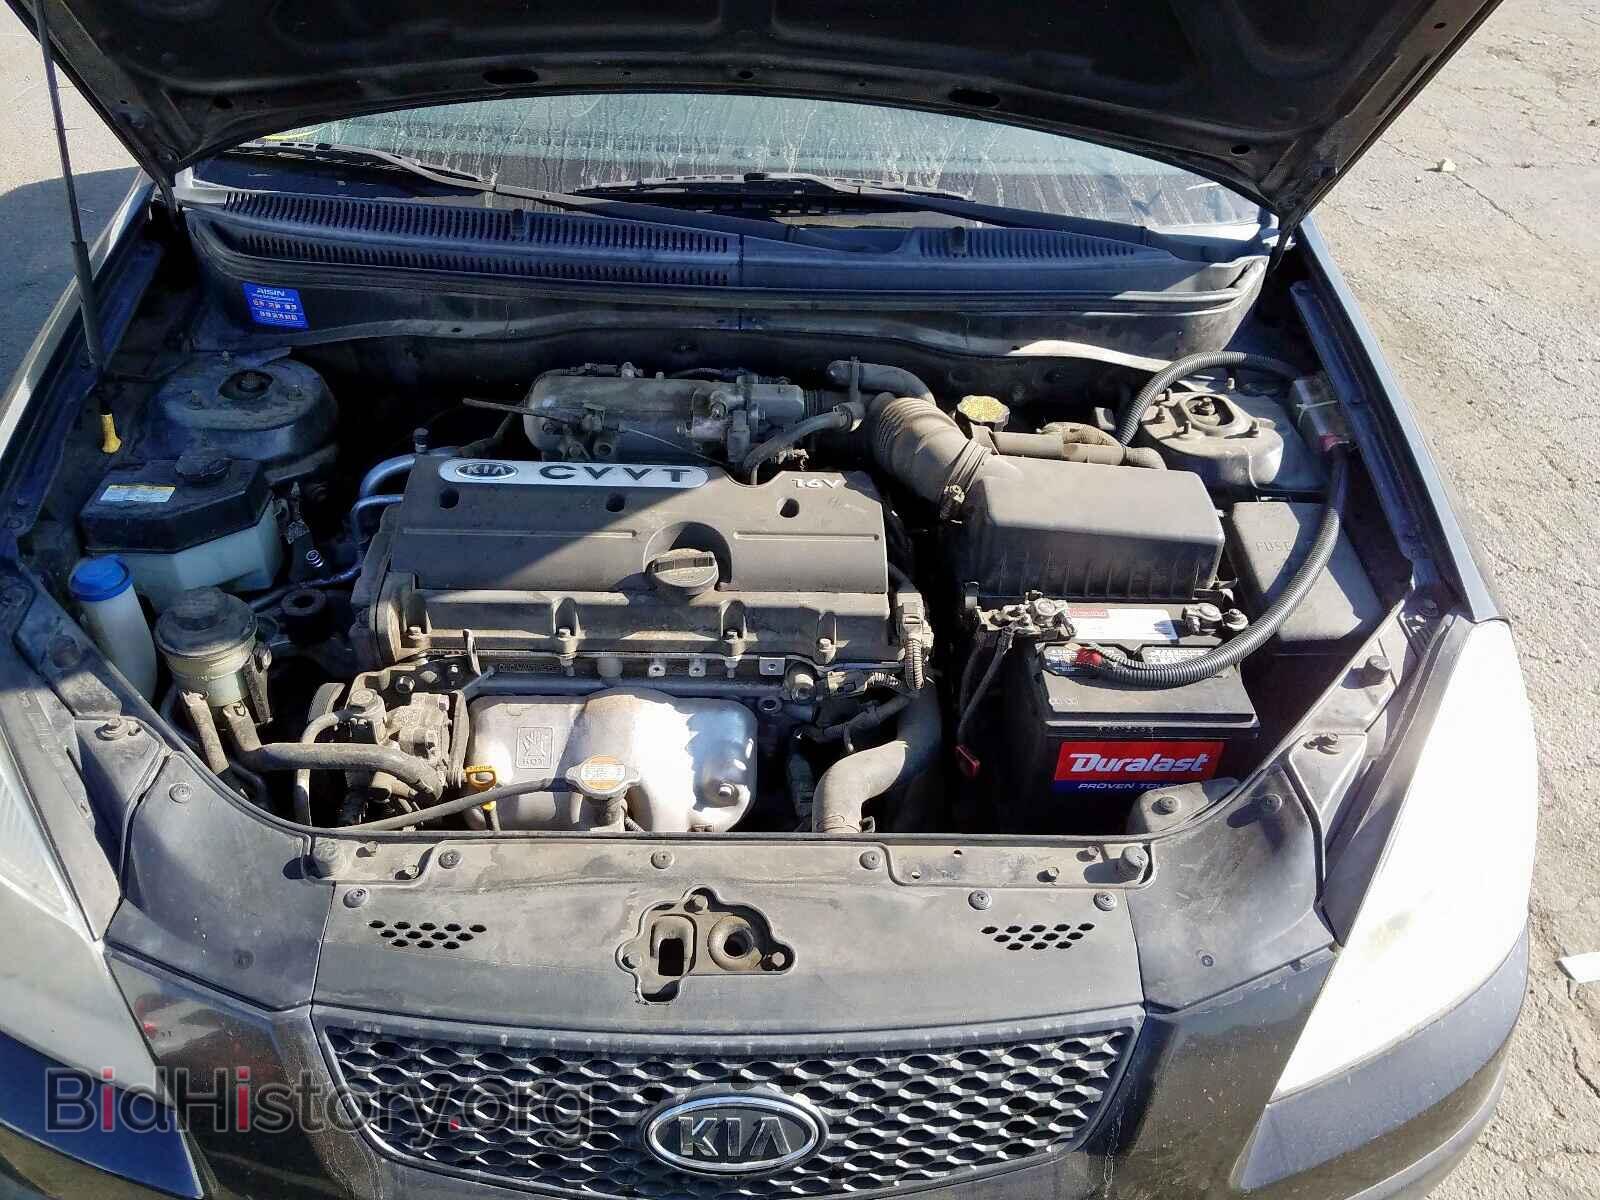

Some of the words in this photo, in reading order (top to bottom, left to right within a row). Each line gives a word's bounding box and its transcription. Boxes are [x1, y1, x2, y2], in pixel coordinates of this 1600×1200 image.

[466, 464, 506, 475] KIA
[539, 464, 692, 483] CVVT
[791, 479, 842, 489] 16V
[1069, 753, 1210, 773] Duralast
[1077, 782, 1135, 790] PROVEN
[678, 1116, 793, 1157] KIA
